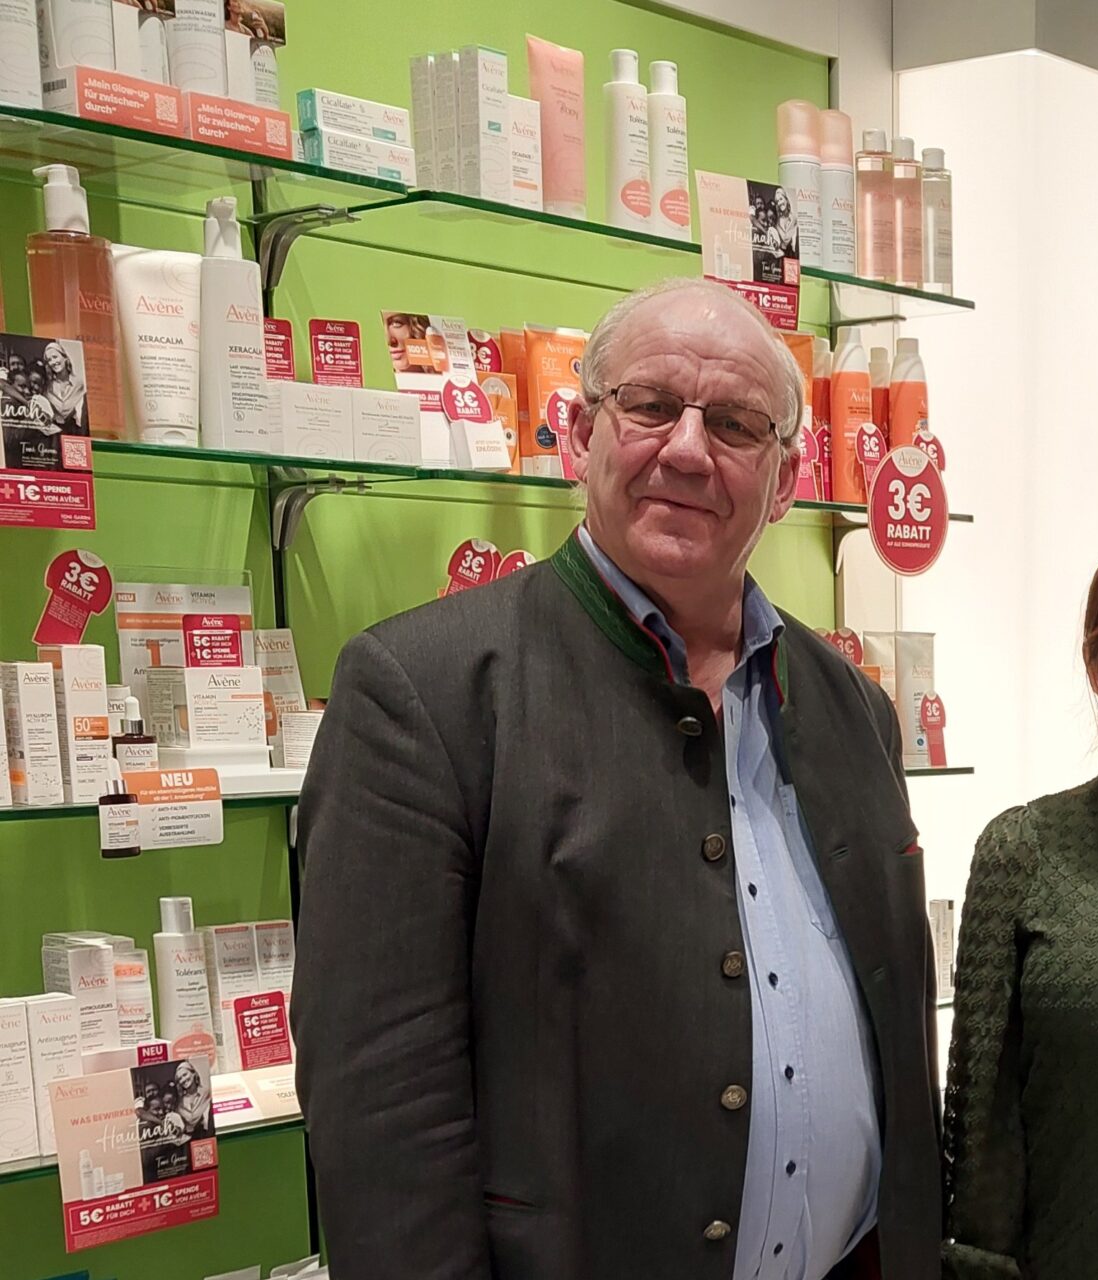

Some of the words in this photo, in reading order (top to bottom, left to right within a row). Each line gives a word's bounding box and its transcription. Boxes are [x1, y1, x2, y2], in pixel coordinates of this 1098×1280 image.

[112, 82, 150, 100] Glow-up
[84, 89, 97, 100] für
[99, 91, 145, 109] zwischen-
[197, 114, 210, 126] für
[212, 117, 255, 133] zwischen-
[224, 108, 260, 126] Glow-up
[136, 295, 184, 315] Avène
[138, 335, 184, 345] XERACALM
[318, 340, 333, 351] 5€
[320, 353, 334, 364] 1€
[452, 390, 479, 408] 3€
[456, 407, 481, 416] RABATT
[863, 435, 879, 450] 3€
[17, 483, 40, 501] 1€
[42, 485, 71, 495] SPENDE
[43, 495, 58, 503] VON
[888, 479, 932, 522] 3€
[887, 523, 931, 540] RABATT
[461, 550, 485, 573] 3€
[64, 561, 99, 592] 3€
[458, 566, 480, 581] RABATT
[59, 579, 93, 601] RABATT
[118, 594, 135, 602] NEU
[155, 592, 183, 604] Avène
[202, 617, 224, 627] Avène
[193, 636, 211, 647] 5€
[255, 636, 290, 651] Avène
[195, 649, 211, 659] 1€
[23, 672, 50, 684] Avène
[71, 677, 102, 689] Avène
[207, 674, 241, 688] Avène
[926, 702, 940, 716] 3€
[160, 772, 194, 787] NEU
[78, 975, 109, 988] Avène
[244, 1015, 259, 1026] 5€
[247, 1028, 261, 1038] 1€
[142, 1046, 164, 1057] NEU
[55, 1084, 88, 1099] Avène
[70, 1116, 91, 1126] WAS
[96, 1118, 176, 1152] Hautnah
[79, 1208, 104, 1226] 5€
[153, 1192, 173, 1209] 1€
[175, 1185, 199, 1196] SPENDE
[120, 1209, 135, 1218] DICH
